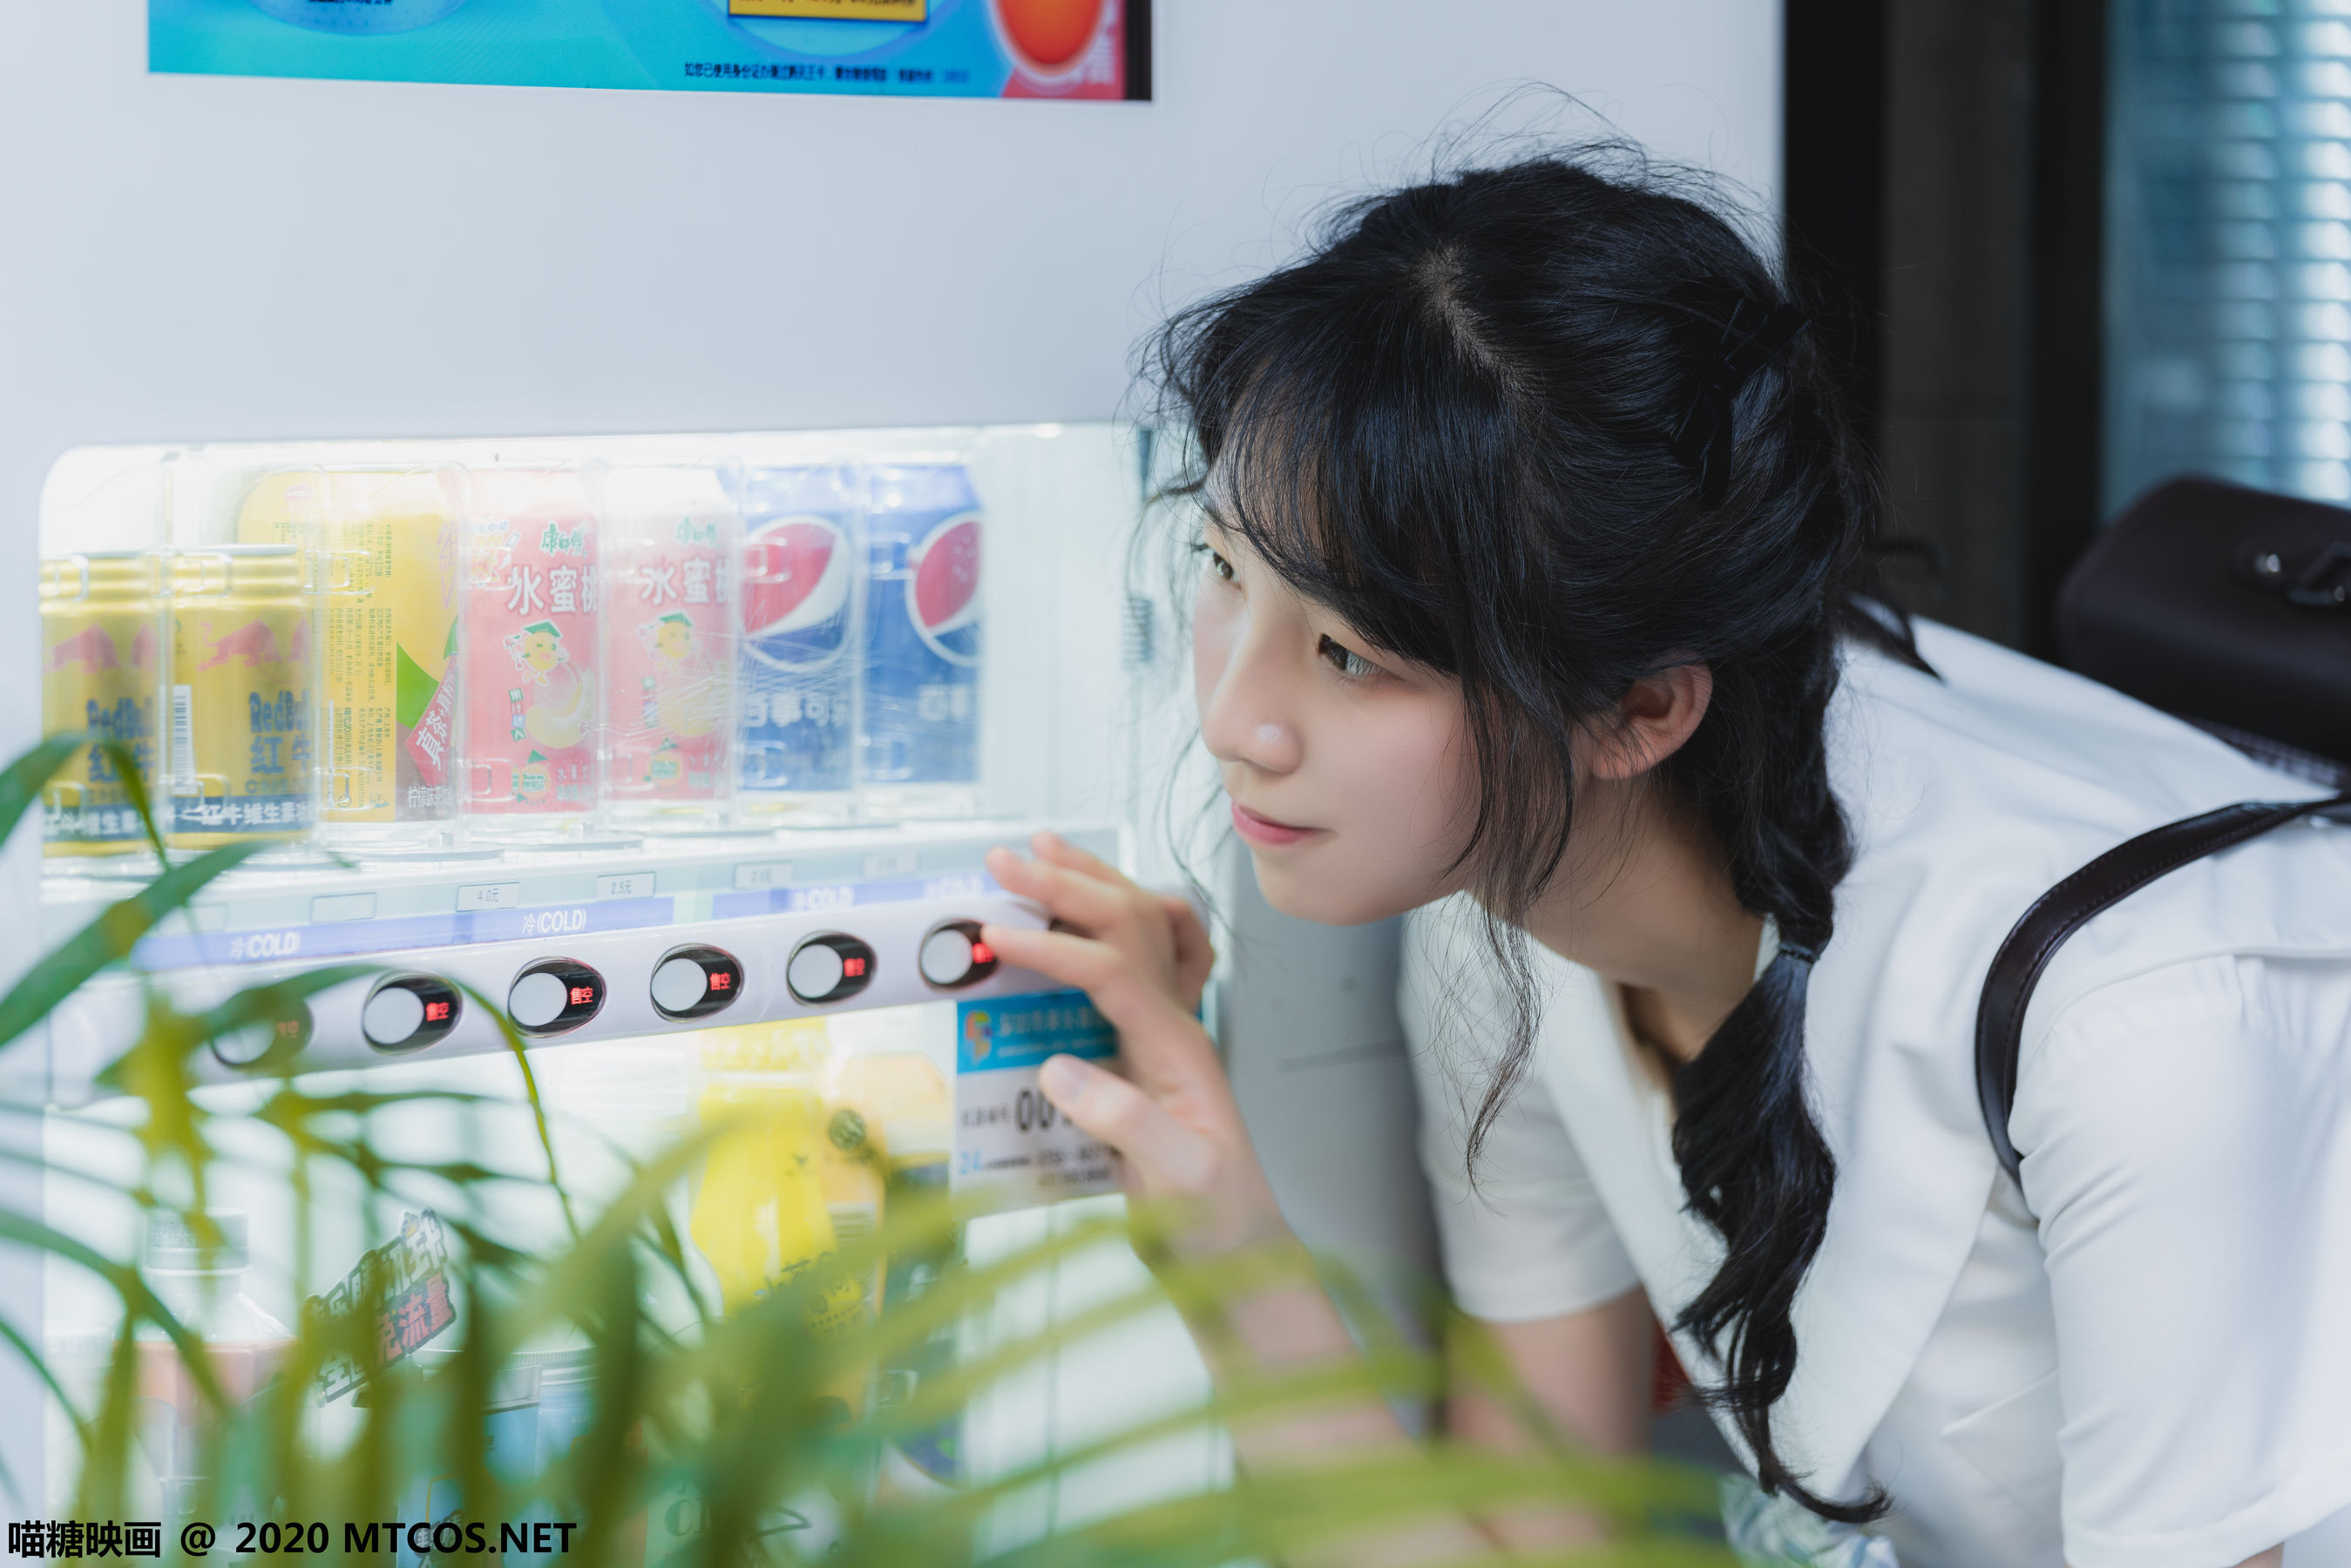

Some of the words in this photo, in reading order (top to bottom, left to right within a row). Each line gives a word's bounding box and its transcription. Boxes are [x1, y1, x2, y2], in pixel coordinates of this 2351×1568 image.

[250, 733, 311, 775] 红牛
[478, 888, 499, 902] 4.0元
[611, 880, 633, 896] 2.5元
[523, 909, 586, 936] 冷(COLD)
[709, 971, 731, 991] 售空
[570, 987, 593, 1005] 售空
[425, 1002, 450, 1022] 售空
